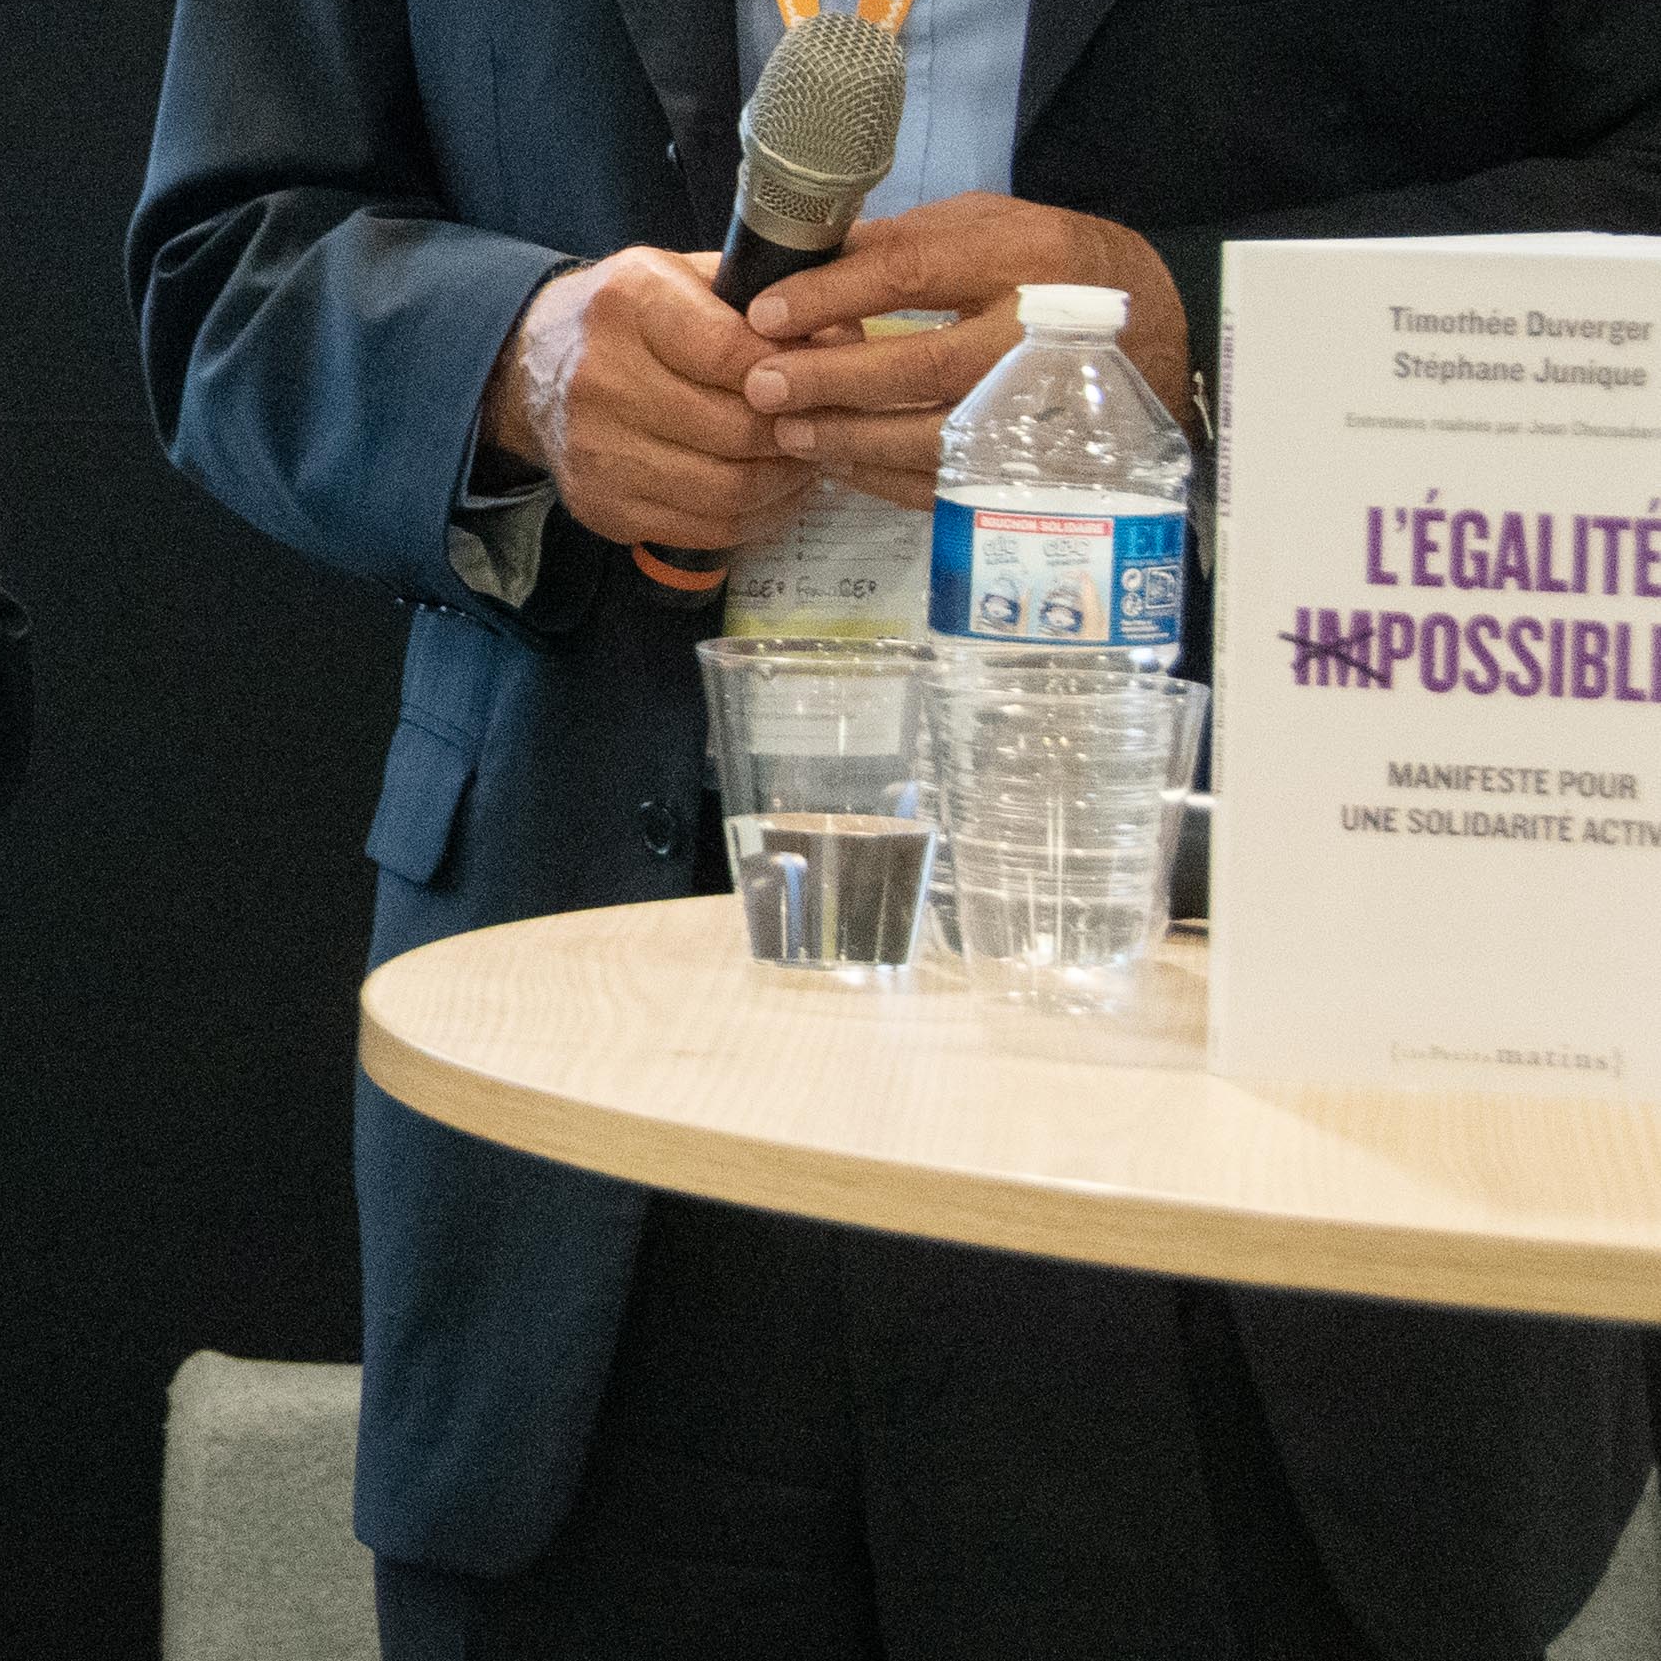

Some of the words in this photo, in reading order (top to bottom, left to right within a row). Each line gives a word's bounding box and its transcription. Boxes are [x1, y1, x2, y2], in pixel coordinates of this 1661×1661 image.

[1388, 305, 1518, 336] Timothée
[1526, 309, 1654, 346] Duverger
[1393, 350, 1525, 384] Stéphane
[1533, 357, 1648, 391] Junique
[1387, 760, 1550, 797] MANIFESTE
[1558, 768, 1640, 802] POUR
[1340, 803, 1399, 834] UNE
[1407, 807, 1575, 844] SOLIDARITÉ
